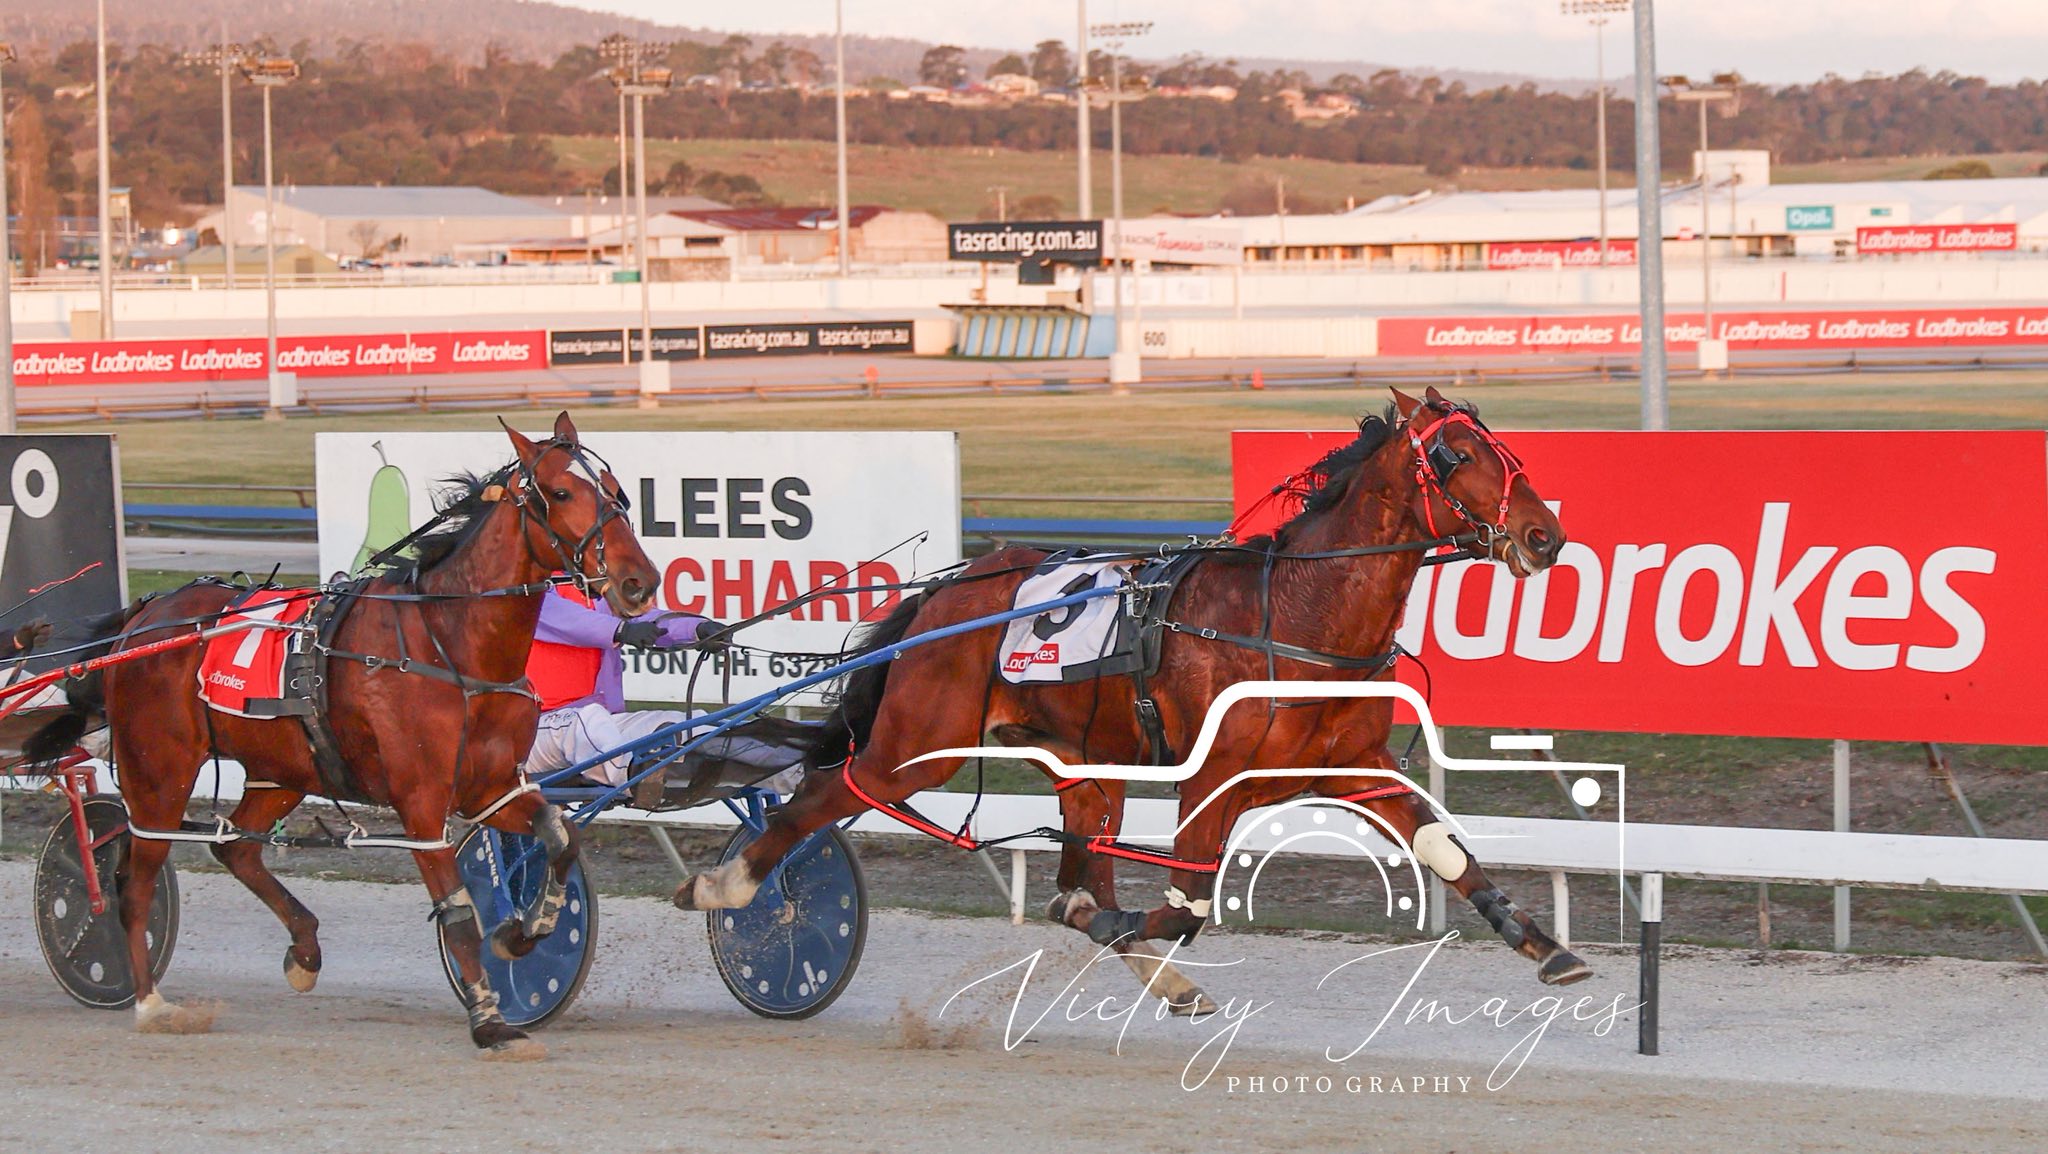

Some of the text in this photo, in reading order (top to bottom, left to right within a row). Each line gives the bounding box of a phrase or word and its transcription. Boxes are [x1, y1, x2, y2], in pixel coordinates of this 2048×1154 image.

[954, 226, 1097, 257] tasracing.com.au
[1859, 228, 2013, 249] Ladbrokes Ladbrokes
[630, 336, 698, 353] tascing.com.au
[710, 329, 809, 351] tasracing.com.au
[818, 326, 909, 349] tasracing.com.au
[1144, 331, 1165, 346] 600
[1426, 326, 1517, 346] Ladbrokes
[1522, 325, 1614, 345] Ladbrokes
[1719, 320, 1811, 341] Ladbrokes
[1818, 319, 1911, 339] Ladbrokes
[1916, 317, 2009, 338] Ladbrokes
[13, 341, 530, 375] adbrokes Ladbrokes Ladbrokes adbrokes Ladbrokes Ladbrokes
[640, 476, 813, 541] LEES
[662, 556, 902, 623] CHARD
[1394, 500, 1997, 673] dbrokes
